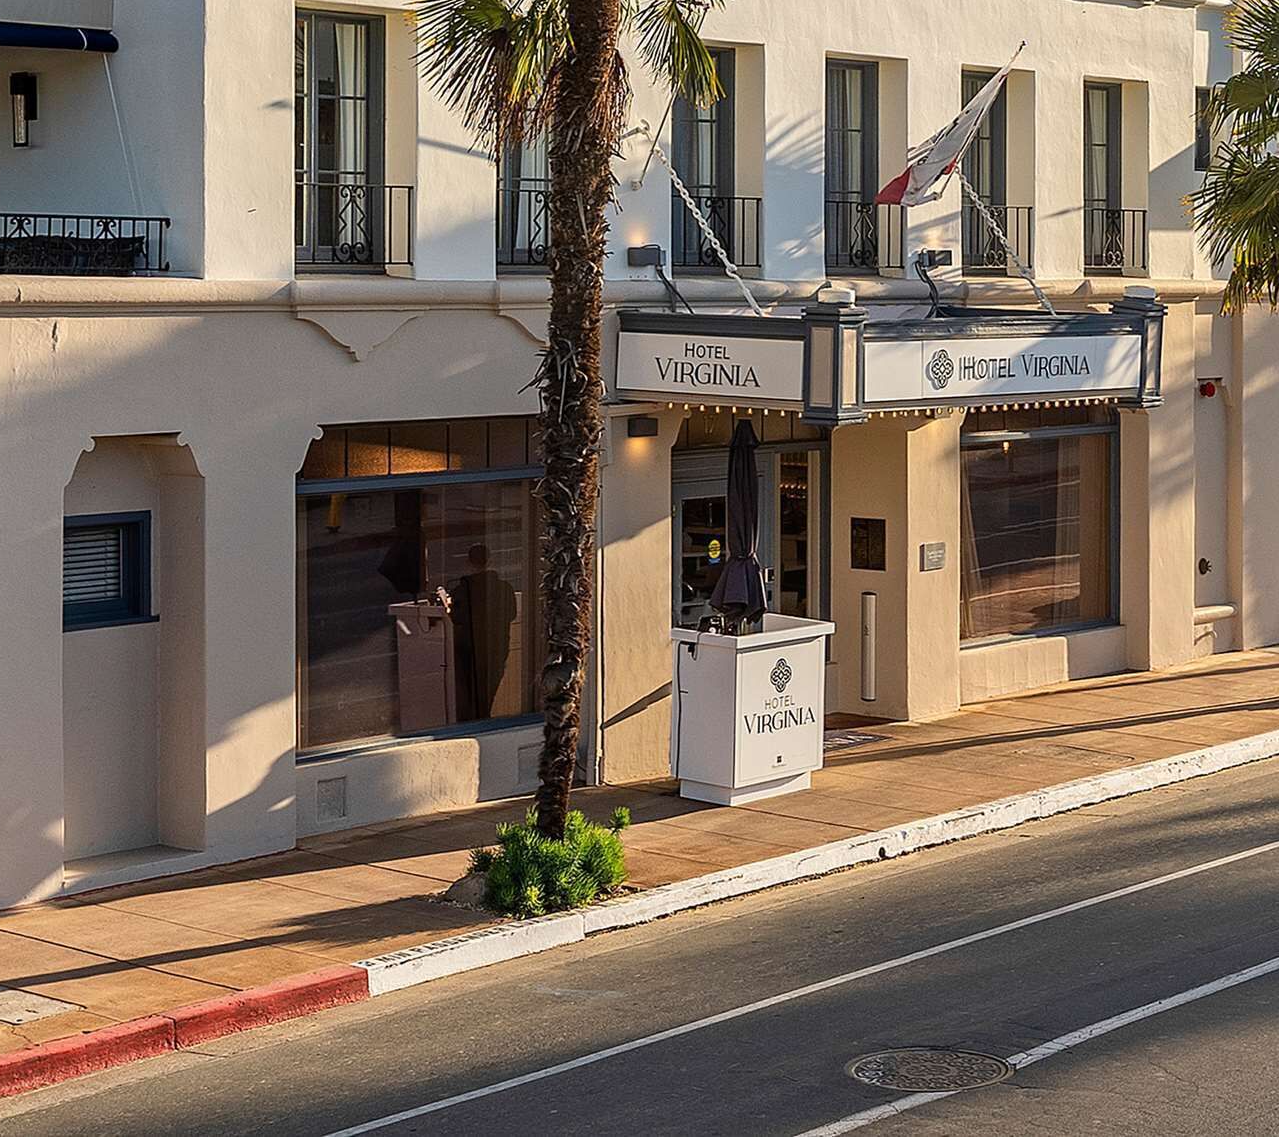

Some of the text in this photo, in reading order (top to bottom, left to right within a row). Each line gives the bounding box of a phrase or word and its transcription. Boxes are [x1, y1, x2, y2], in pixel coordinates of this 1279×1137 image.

[684, 342, 731, 360] HOTEL
[654, 357, 761, 388] VIRGINIA
[960, 353, 1090, 381] HOTEL VIRGINIA
[764, 695, 796, 711] HOTEL
[742, 706, 816, 735] VIRGINIA
